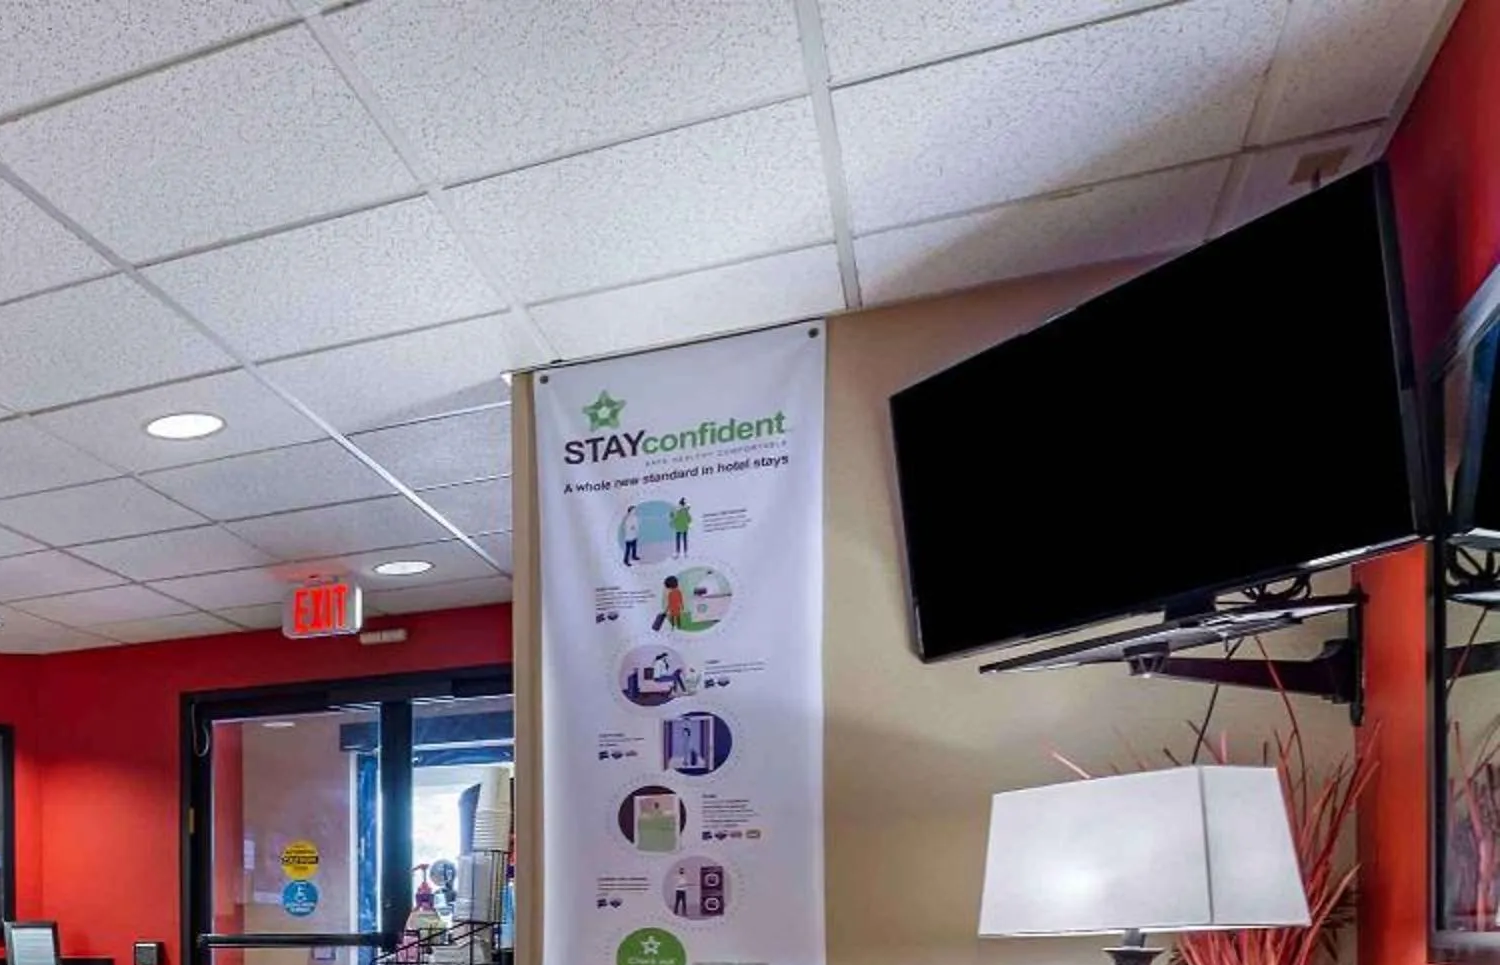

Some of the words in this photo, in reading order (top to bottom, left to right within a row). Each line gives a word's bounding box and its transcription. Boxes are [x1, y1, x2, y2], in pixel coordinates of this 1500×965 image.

[564, 484, 573, 494] A
[576, 480, 611, 492] whole
[614, 477, 639, 488] new
[643, 466, 699, 484] standard
[702, 464, 713, 475] in
[717, 459, 750, 473] hotel
[754, 455, 789, 468] stays
[294, 583, 348, 633] EXIT
